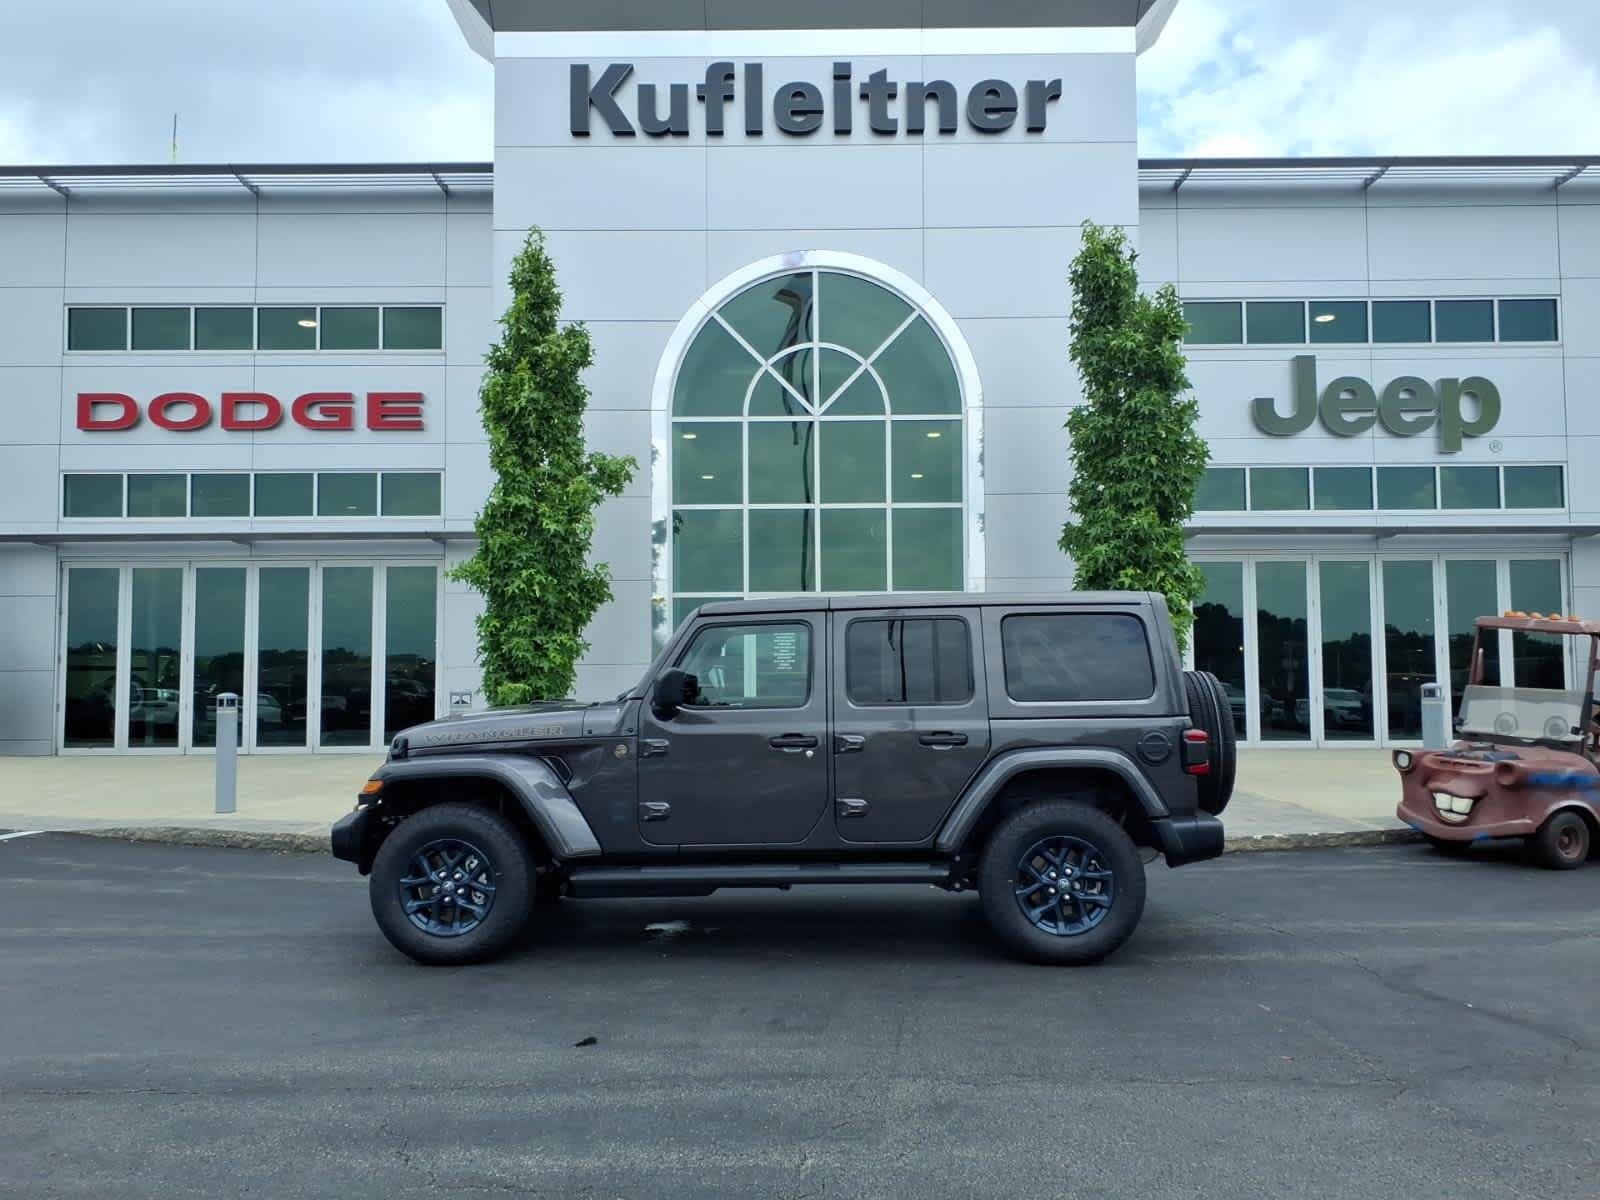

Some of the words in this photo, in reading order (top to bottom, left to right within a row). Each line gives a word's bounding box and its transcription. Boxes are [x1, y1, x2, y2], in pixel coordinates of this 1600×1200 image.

[570, 61, 1062, 137] Kufleitner
[77, 392, 425, 431] DODGE
[1252, 355, 1501, 455] Jeep
[424, 725, 565, 743] WRANGLER
